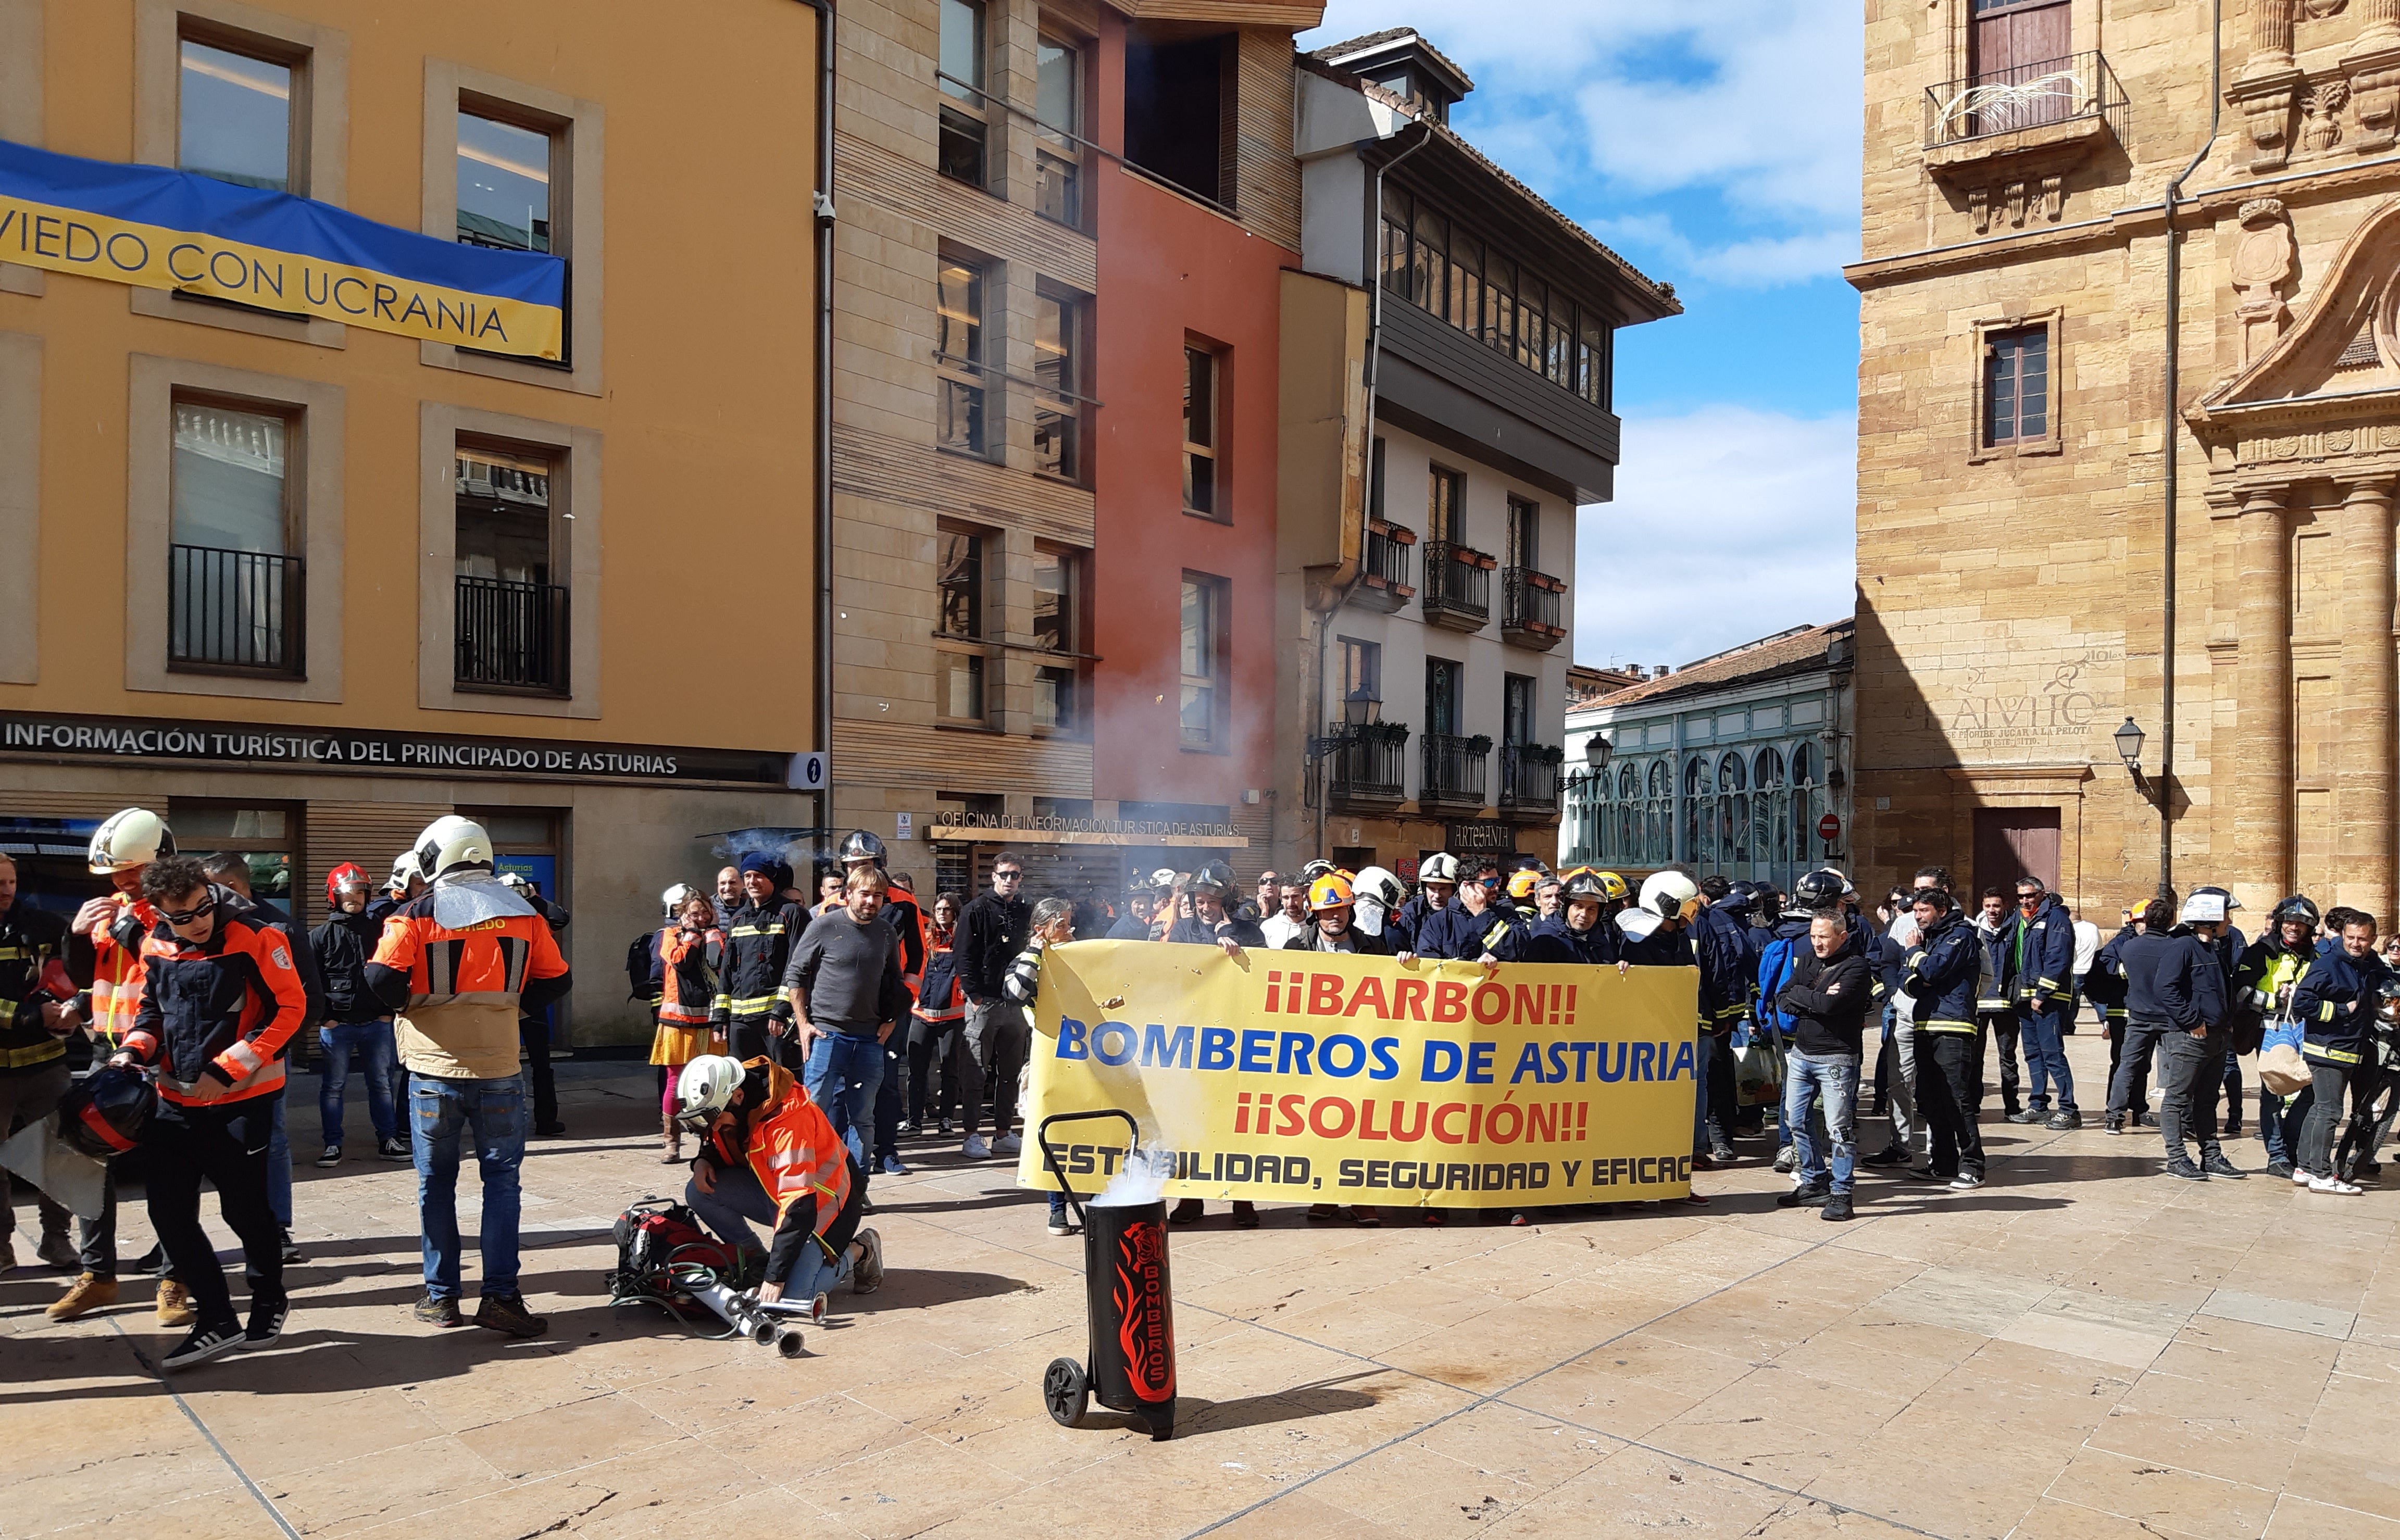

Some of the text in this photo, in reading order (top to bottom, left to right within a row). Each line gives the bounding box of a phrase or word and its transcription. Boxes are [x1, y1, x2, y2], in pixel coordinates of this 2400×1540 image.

[168, 244, 284, 299] CON
[304, 267, 509, 343] UCRANIA
[5, 723, 678, 774] INFORMACIÓN TURÍSTICA DEL PRINCIPADO DE ASTURIAS
[1998, 729, 2029, 738] JUGAR
[2041, 728, 2054, 736] LA
[2056, 727, 2093, 735] PELOTA
[1001, 814, 1019, 829] DE
[1173, 822, 1187, 835] DE
[1190, 823, 1239, 836] ASTURIAS
[498, 863, 533, 872] Asturias
[1055, 1015, 1697, 1084] BOMBEROS DE ASTURIA
[1339, 1159, 1548, 1191] SEGURIDAD
[1563, 1159, 1583, 1186] Y
[1144, 1266, 1165, 1381] BOMBEROS
